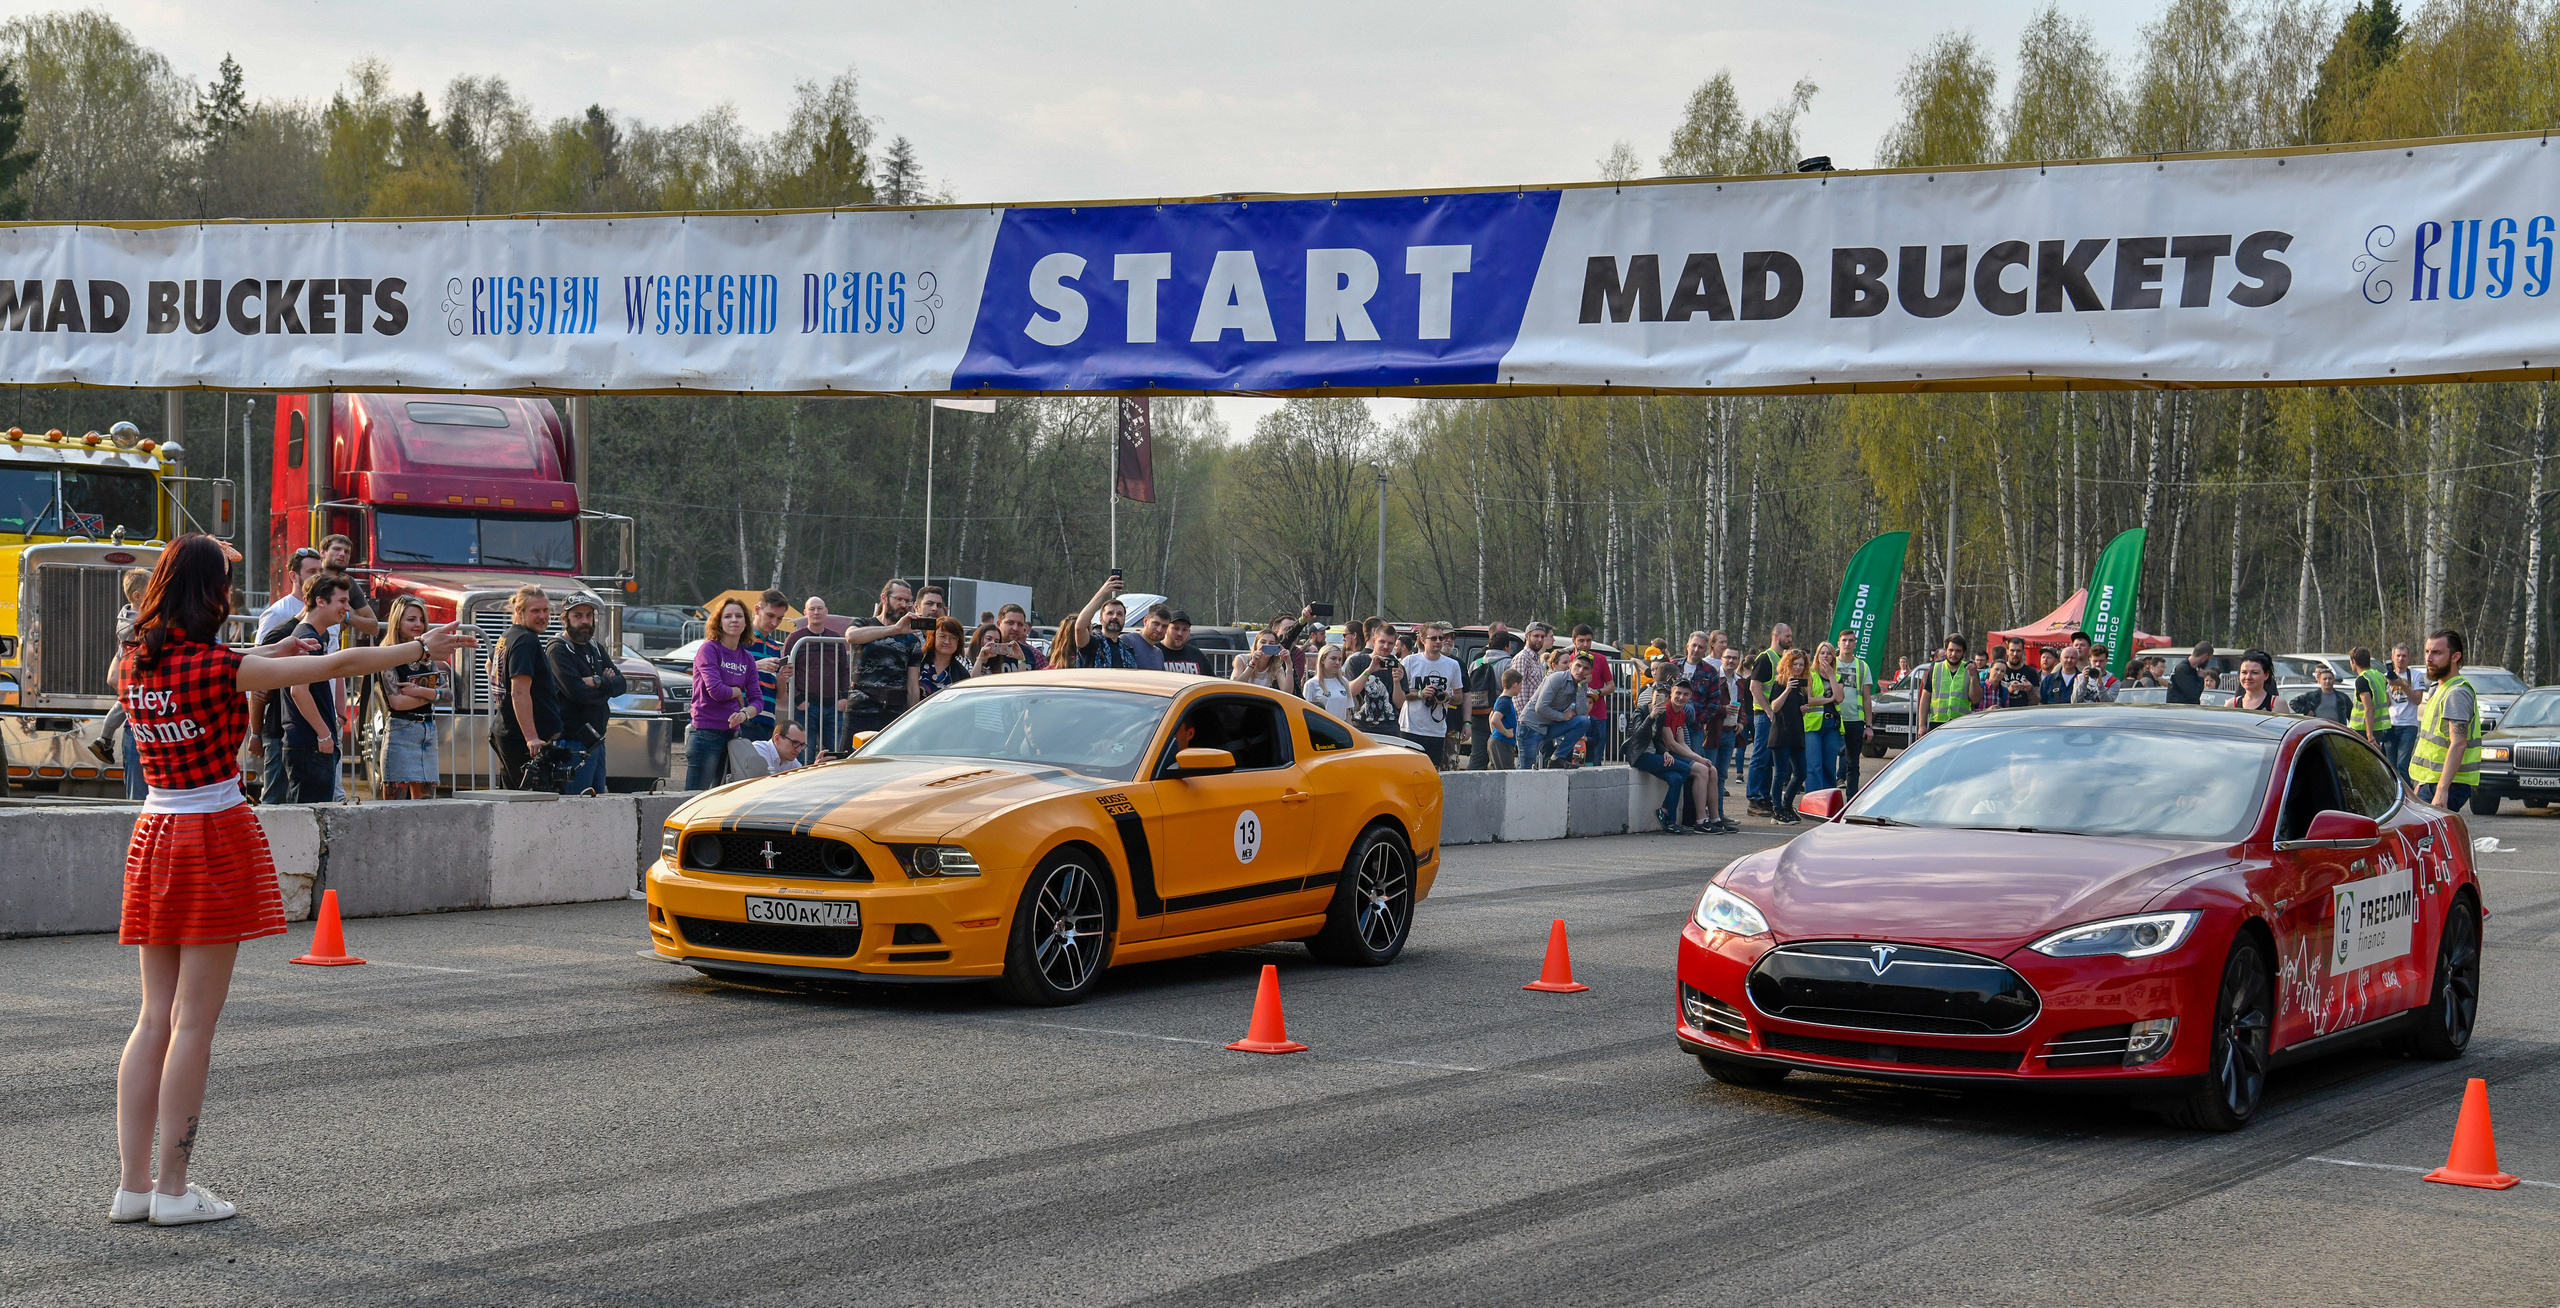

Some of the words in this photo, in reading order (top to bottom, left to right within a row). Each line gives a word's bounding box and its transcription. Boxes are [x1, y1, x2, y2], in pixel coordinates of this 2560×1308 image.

[1578, 251, 1804, 324] MAD
[1830, 231, 2295, 319] BUCKETS
[0, 279, 131, 333] MAD
[146, 278, 409, 335] BUCKETS
[472, 276, 599, 335] RUSSIAN
[625, 274, 778, 335] WEEKEND
[802, 271, 907, 335] DRAGS
[1024, 244, 1472, 347] START
[1850, 584, 1870, 643] EEDOM
[2094, 585, 2114, 643] EEDOM
[1856, 613, 1875, 659] finance
[127, 684, 177, 716] Hey,
[128, 715, 156, 743] iss
[154, 719, 206, 743] me.
[1096, 793, 1128, 805] BOSS
[1106, 803, 1135, 815] 302
[1239, 820, 1255, 845] 13
[824, 903, 852, 918] 777
[2341, 906, 2351, 934] 12
[2360, 890, 2411, 928] FREEDOM
[2357, 931, 2385, 952] finance
